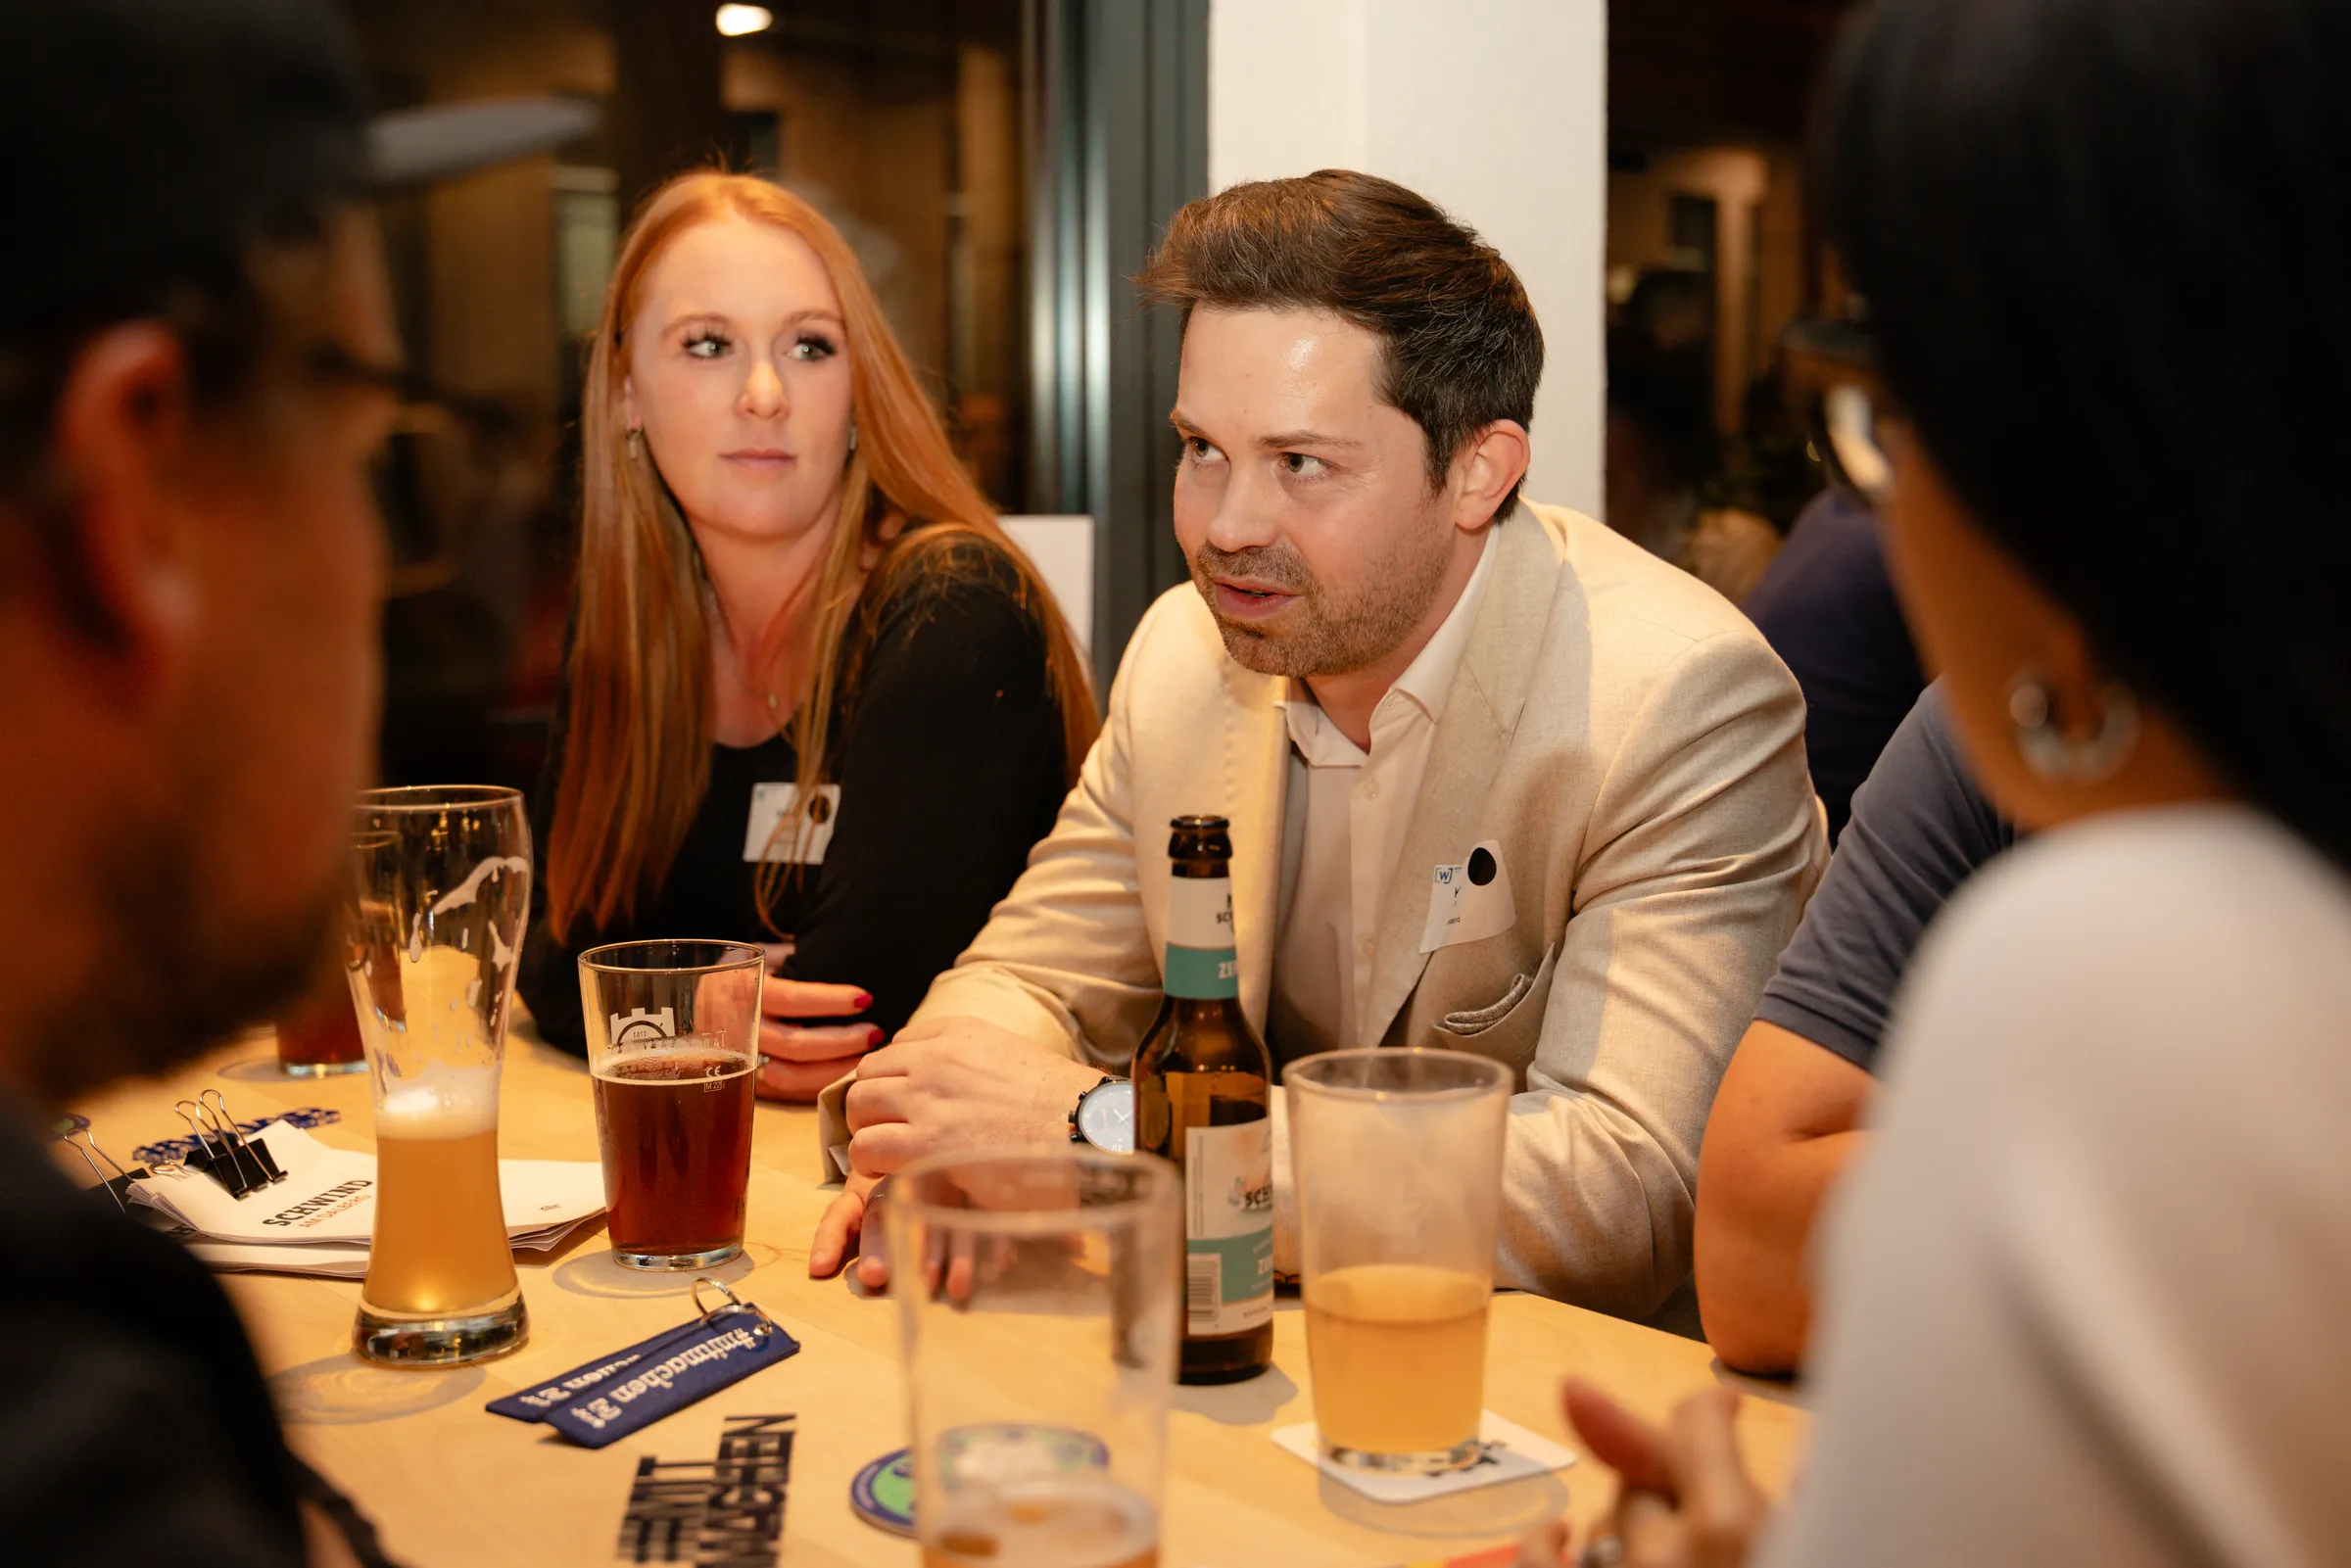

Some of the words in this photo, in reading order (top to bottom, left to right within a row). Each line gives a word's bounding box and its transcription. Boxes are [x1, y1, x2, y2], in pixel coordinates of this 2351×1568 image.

[263, 1179, 373, 1226] SCHWIND
[298, 1215, 326, 1228] AM
[317, 1195, 371, 1219] DALBERG
[608, 1327, 756, 1403] #mitmachen
